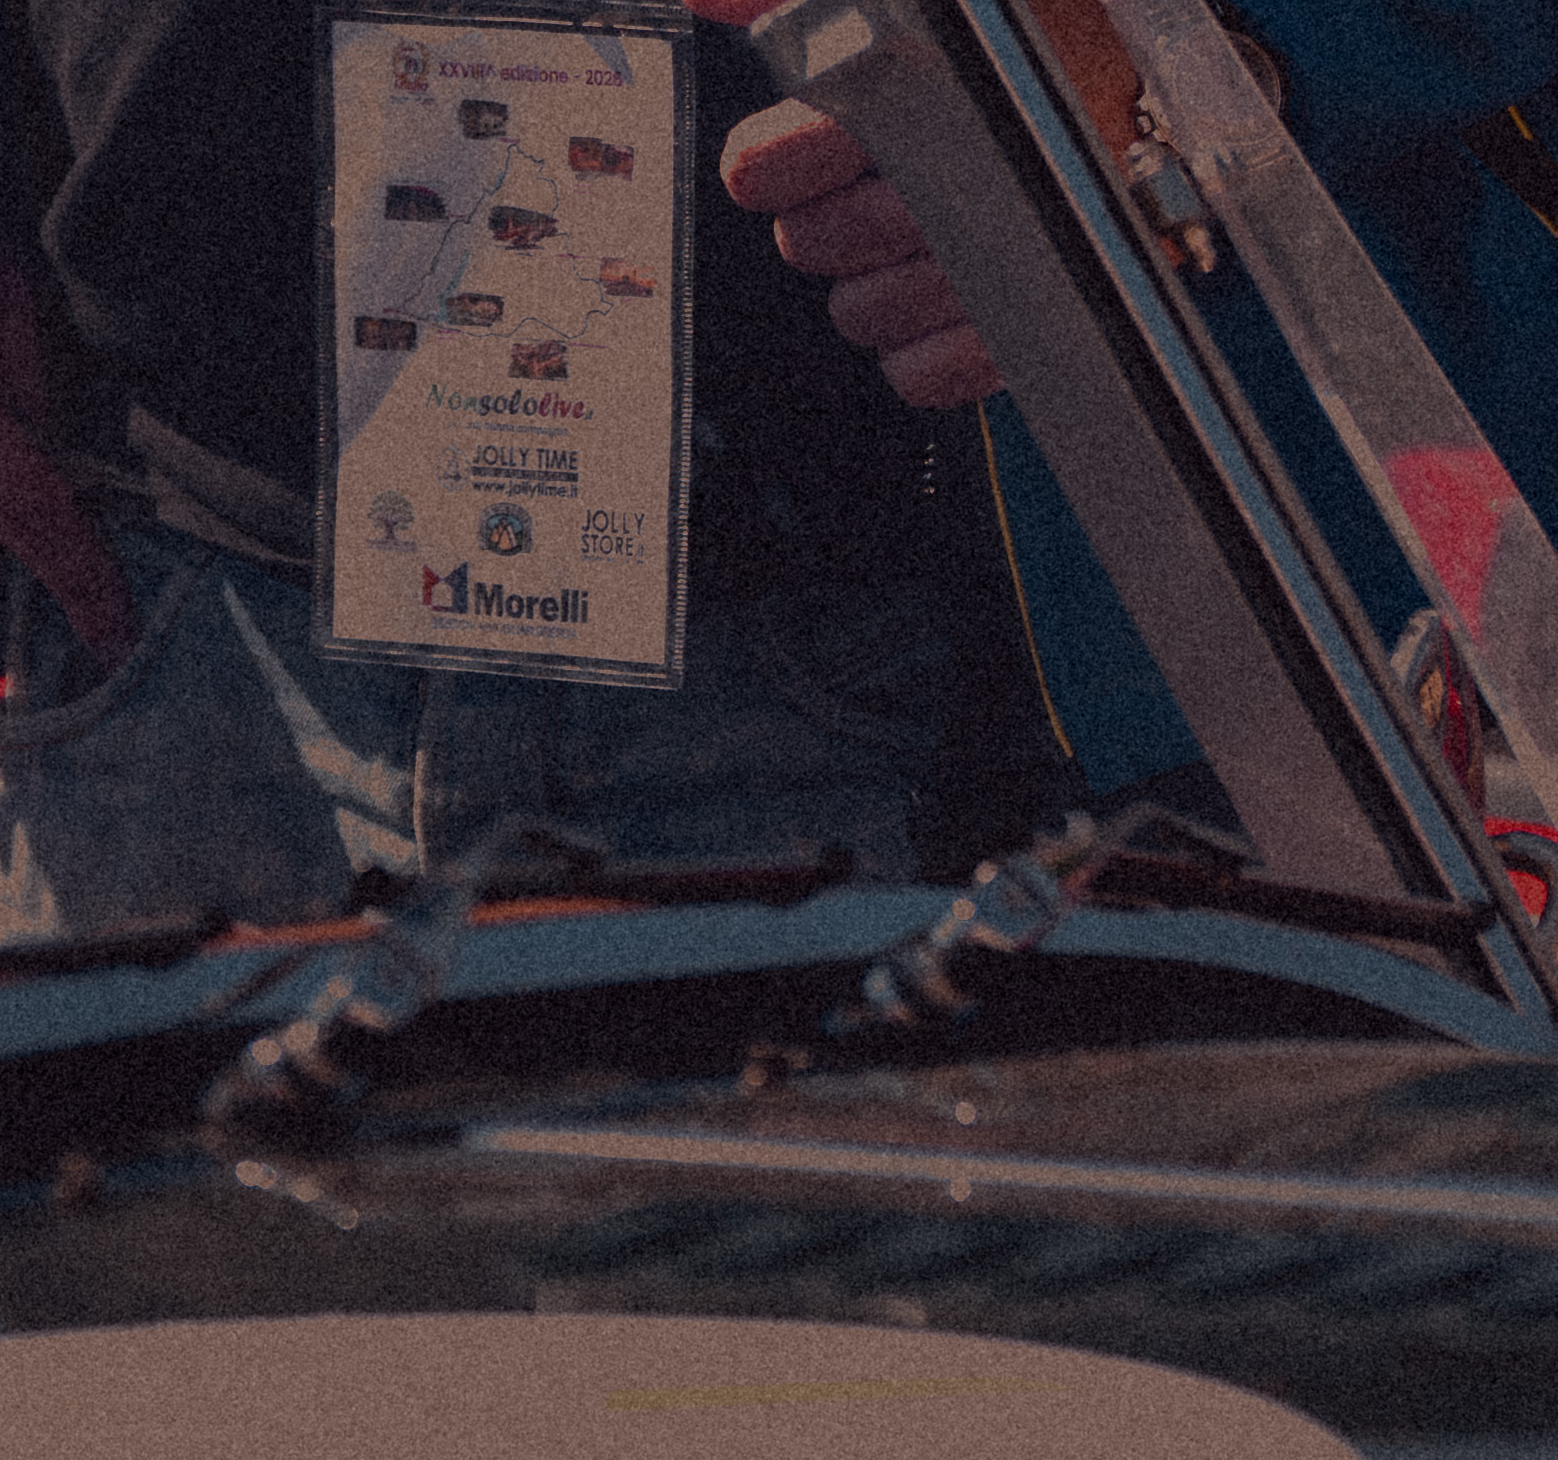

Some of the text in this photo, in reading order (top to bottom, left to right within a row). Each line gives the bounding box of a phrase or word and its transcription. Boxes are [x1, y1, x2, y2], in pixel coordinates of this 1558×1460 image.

[500, 63, 570, 84] edizione
[472, 445, 579, 471] JOLLY TIME
[472, 480, 579, 499] www.jollytime.it
[581, 508, 646, 536] JOLLY
[473, 581, 590, 625] Morelli
